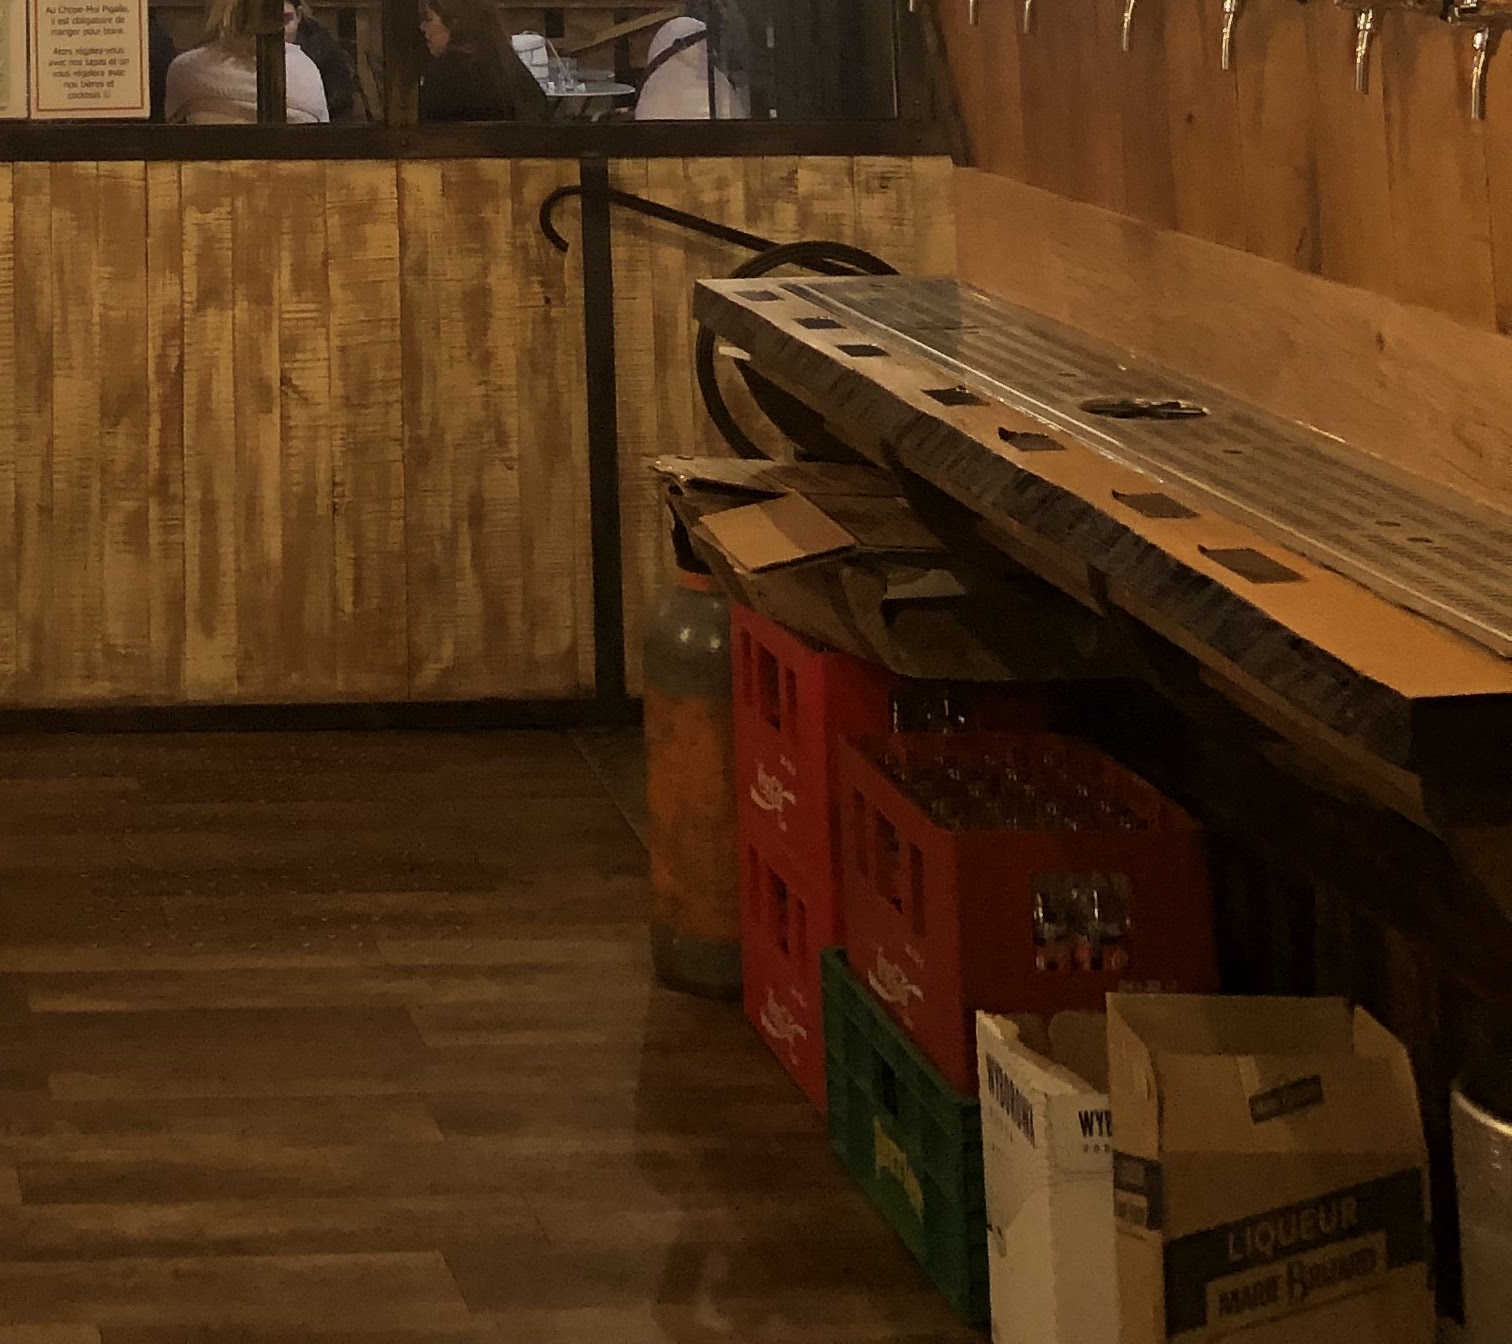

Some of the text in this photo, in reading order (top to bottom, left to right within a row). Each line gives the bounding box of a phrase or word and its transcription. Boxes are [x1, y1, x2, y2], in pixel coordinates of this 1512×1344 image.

[72, 17, 112, 26] obligatoire
[51, 29, 80, 37] manger
[1078, 1109, 1113, 1138] WYB
[1228, 1195, 1359, 1262] LIQUEUR
